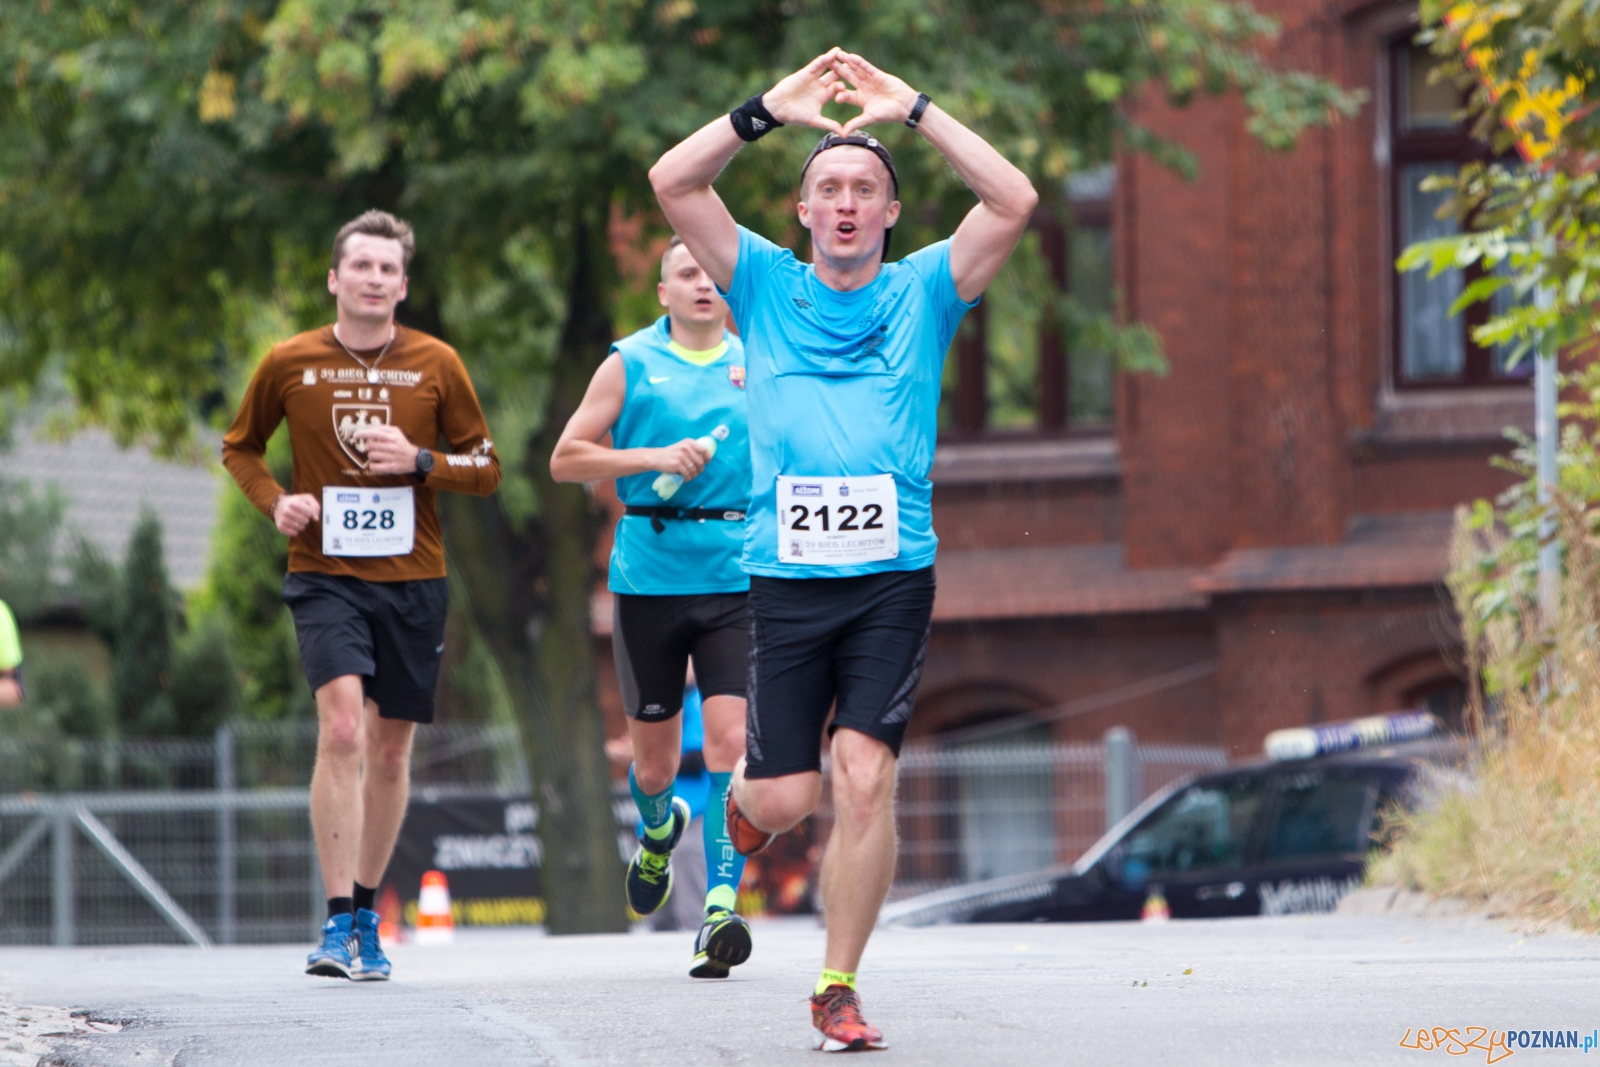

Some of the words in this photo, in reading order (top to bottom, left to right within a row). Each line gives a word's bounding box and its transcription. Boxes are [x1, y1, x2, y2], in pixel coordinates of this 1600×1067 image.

[320, 368, 336, 379] 39
[338, 368, 364, 379] BIEG
[343, 509, 395, 530] 828
[790, 503, 884, 532] 2122
[818, 540, 839, 549] BIEG
